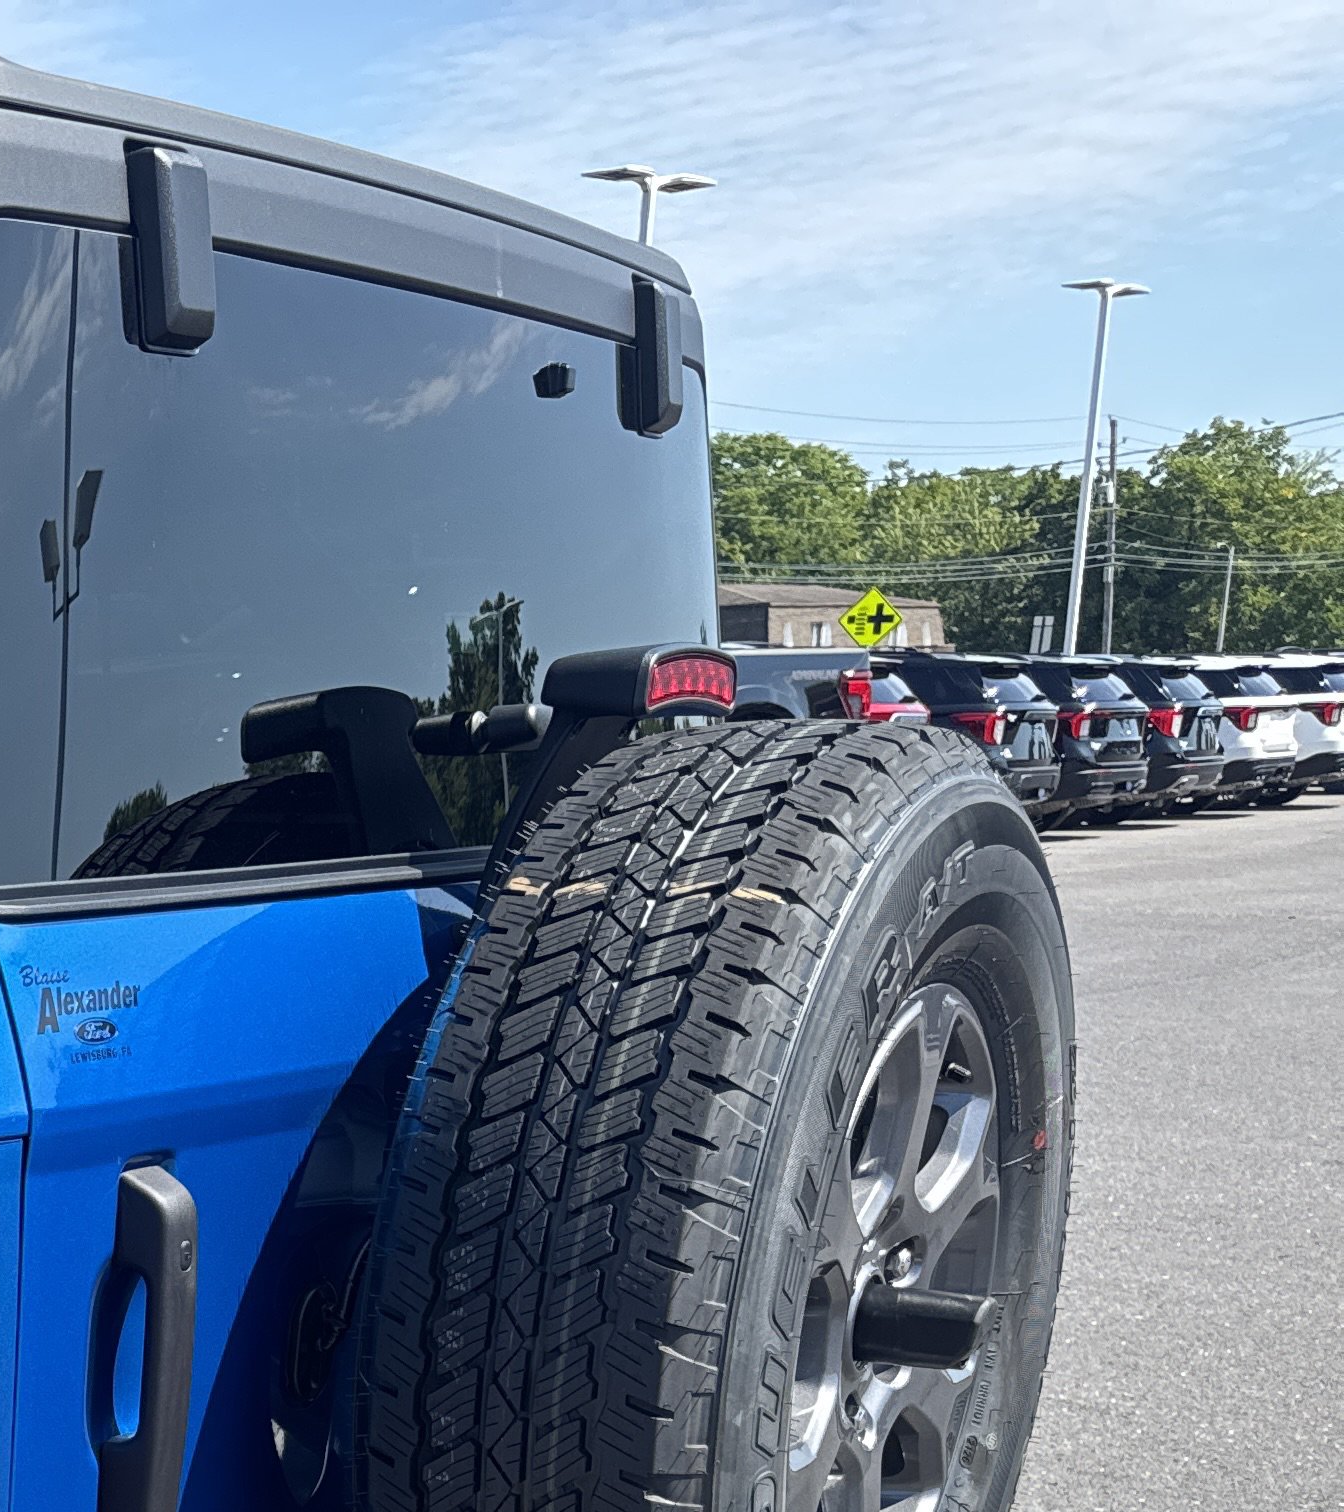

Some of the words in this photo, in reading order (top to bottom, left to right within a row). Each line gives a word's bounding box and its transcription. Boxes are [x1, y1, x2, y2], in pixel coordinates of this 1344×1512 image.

[917, 838, 975, 937] A/T
[19, 964, 70, 988] Blaise
[37, 980, 141, 1034] Alexander
